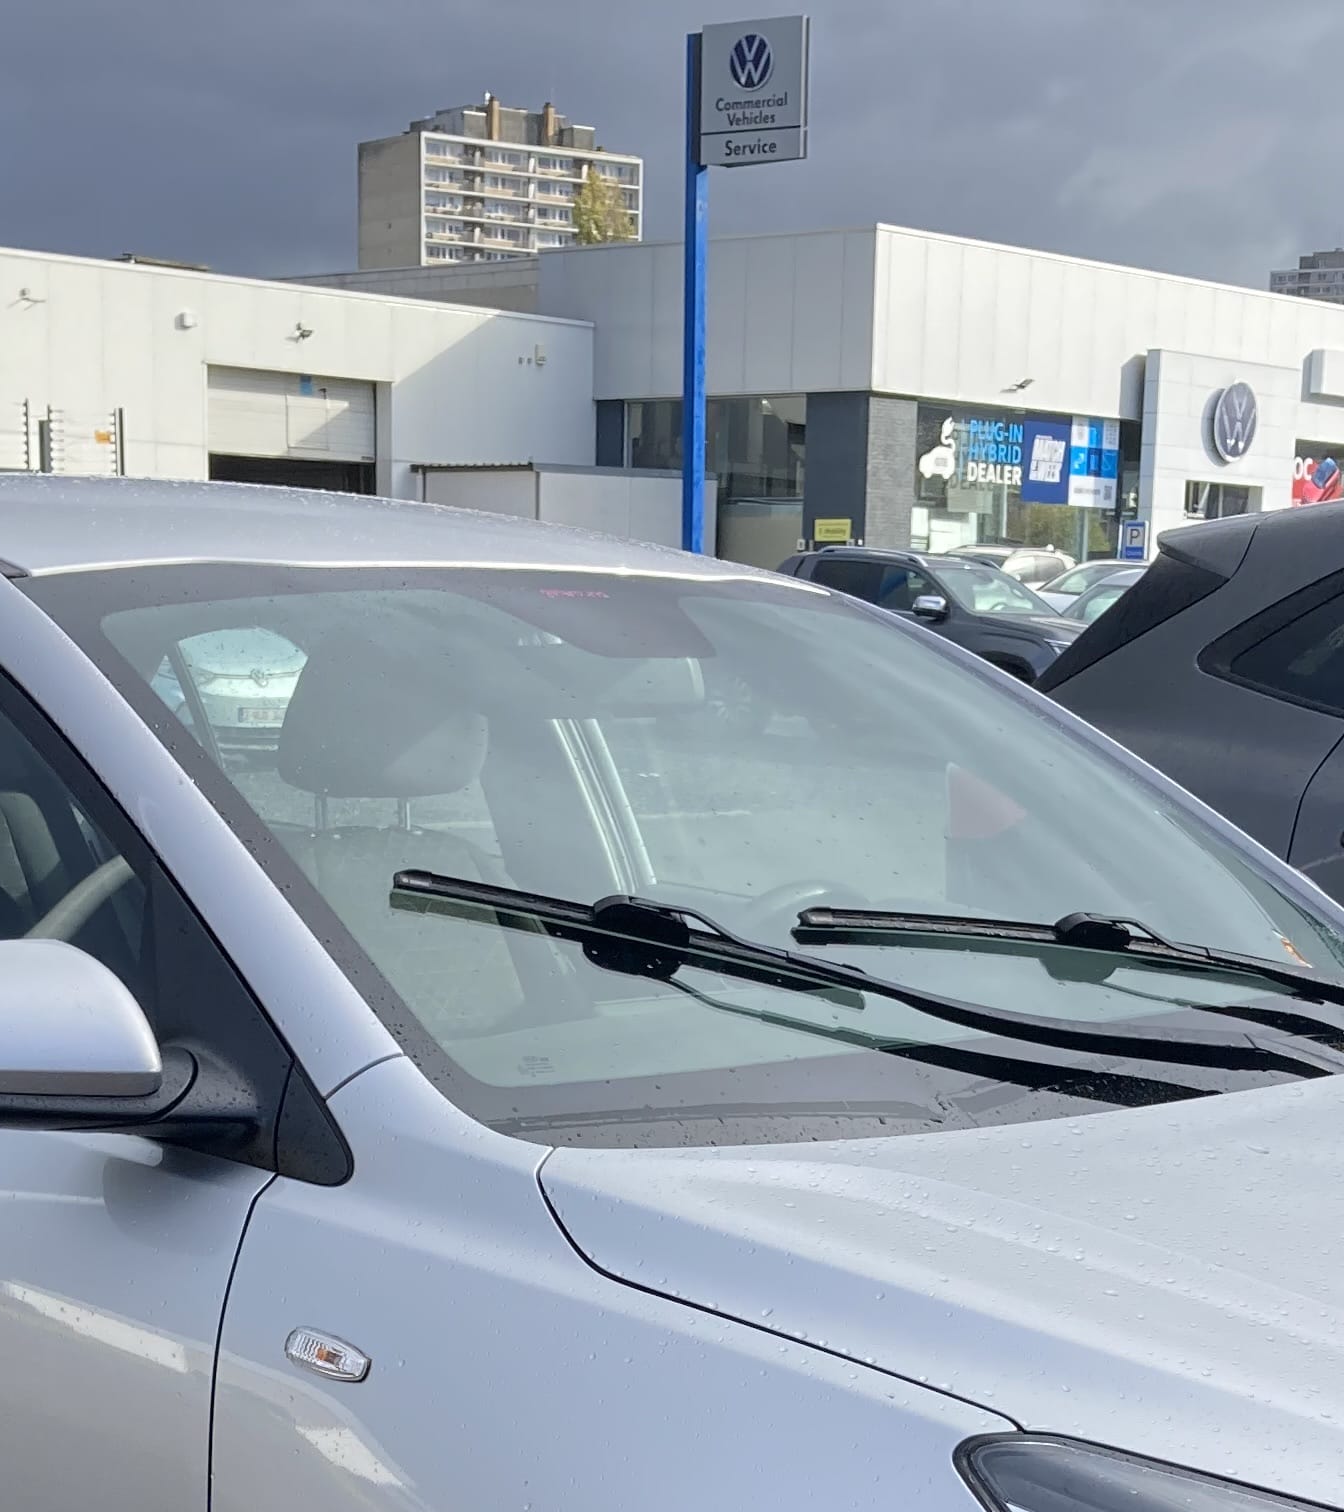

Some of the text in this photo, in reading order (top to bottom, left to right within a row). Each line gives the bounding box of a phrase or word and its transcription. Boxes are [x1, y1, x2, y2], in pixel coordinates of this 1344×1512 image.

[716, 92, 788, 112] Commercial
[727, 111, 776, 126] Vehicles
[725, 139, 777, 156] Service
[969, 419, 1024, 443] PLUG-IN
[968, 443, 1022, 464] HYBRID
[967, 461, 1022, 486] DEALER
[1129, 528, 1141, 545] P
